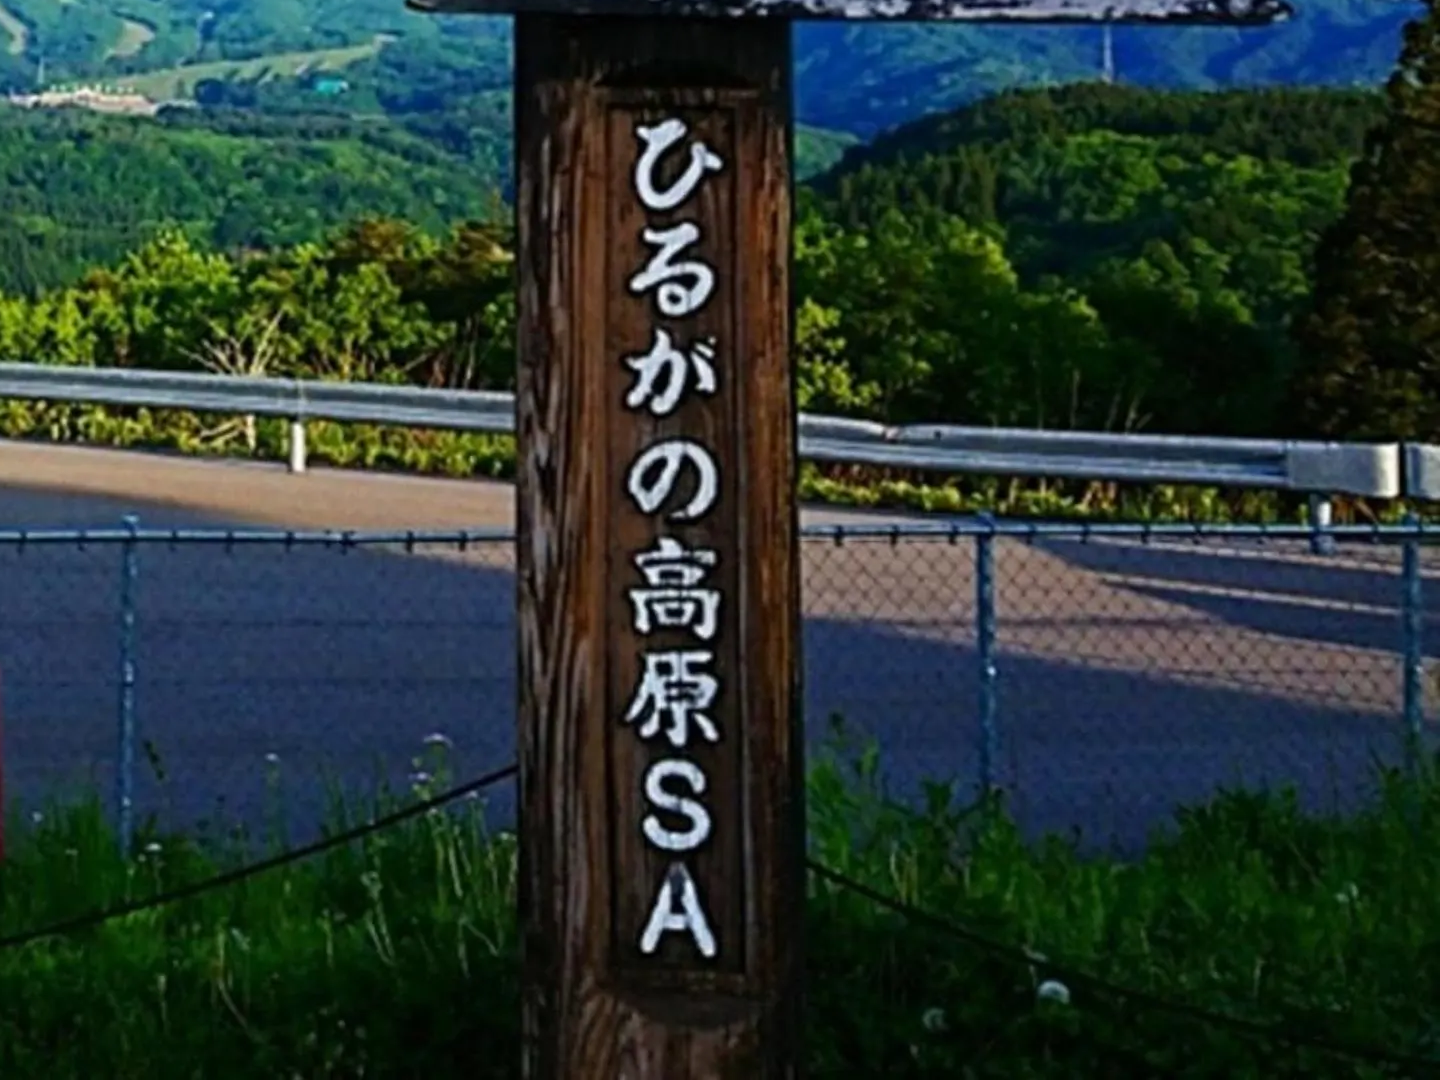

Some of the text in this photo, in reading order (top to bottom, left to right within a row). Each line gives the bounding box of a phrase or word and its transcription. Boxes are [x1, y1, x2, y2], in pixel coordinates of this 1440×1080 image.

[626, 119, 722, 957] ひるがの高原SA
